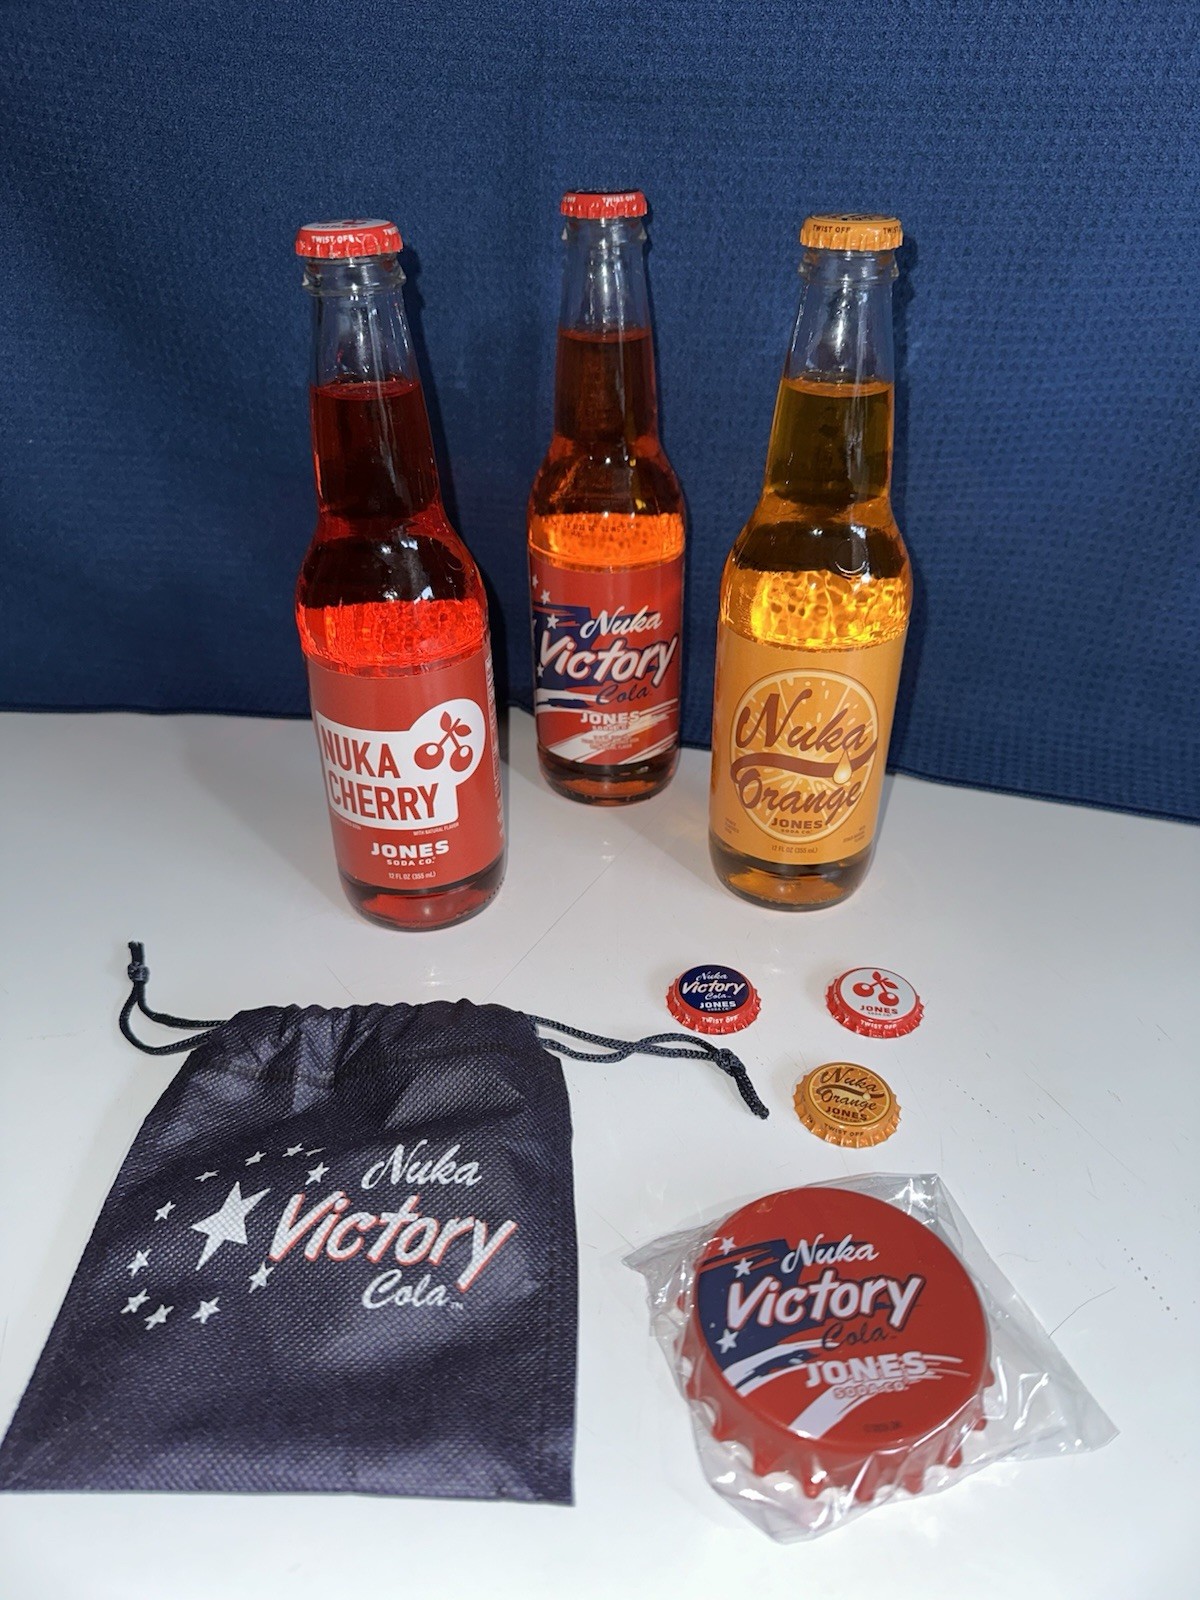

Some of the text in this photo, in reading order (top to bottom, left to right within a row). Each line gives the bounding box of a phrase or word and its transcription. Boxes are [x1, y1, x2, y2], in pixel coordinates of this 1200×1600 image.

[811, 224, 833, 233] TWIST
[311, 234, 355, 244] TWIST OFF
[579, 604, 663, 639] Nuka
[540, 630, 680, 689] Victory
[596, 683, 650, 706] Cola
[580, 710, 640, 725] JONES
[735, 688, 868, 753] Nuka
[320, 724, 401, 779] NUKA
[327, 769, 439, 821] CHERRY
[737, 768, 862, 826] Orange
[425, 826, 443, 835] NATURAL
[443, 821, 460, 832] FLAVOR
[771, 817, 823, 830] JONES
[371, 840, 450, 859] JONES
[395, 872, 402, 880] FL
[403, 872, 410, 880] OZ
[412, 872, 425, 880] (355
[425, 871, 437, 879] mL)
[695, 971, 728, 981] Nuka
[682, 980, 746, 996] Victory
[704, 992, 727, 1000] Cola
[699, 1000, 737, 1009] JONES
[860, 1005, 898, 1015] JONES
[701, 1014, 739, 1024] TWIST OFF
[860, 1020, 882, 1029] TWIST
[820, 1067, 879, 1092] Nuka
[821, 1088, 877, 1113] Orange
[825, 1106, 868, 1121] JONES
[824, 1123, 846, 1136] TWIST
[361, 1139, 482, 1190] Nuka
[268, 1190, 518, 1293] Victory
[780, 1234, 880, 1274] Nuka
[361, 1268, 450, 1309] Cola
[727, 1268, 925, 1332] Victory
[821, 1321, 888, 1351] Cola
[805, 1351, 927, 1388] JONES
[833, 1383, 878, 1399] SODA
